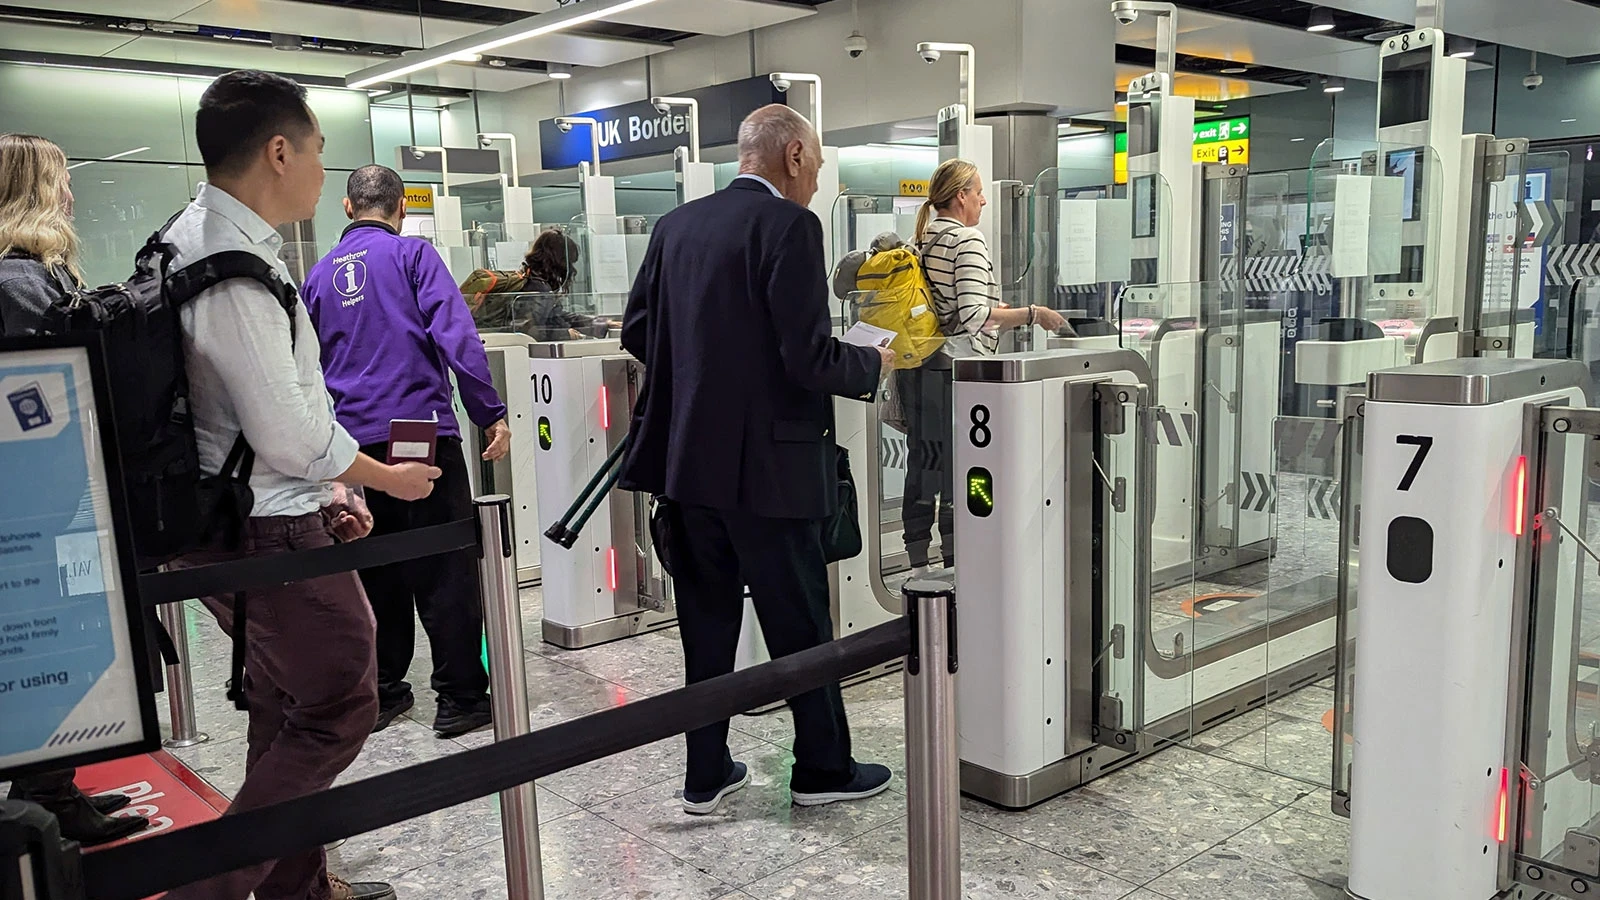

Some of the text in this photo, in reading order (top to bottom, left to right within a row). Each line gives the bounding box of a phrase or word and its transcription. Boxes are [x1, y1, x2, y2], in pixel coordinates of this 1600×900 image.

[1402, 34, 1409, 51] 8
[1141, 78, 1147, 91] 9
[597, 113, 690, 147] UK Border
[1199, 128, 1217, 138] exit
[1196, 148, 1215, 158] Exit
[333, 249, 368, 264] Heathrow
[342, 294, 365, 307] Helpers
[531, 373, 552, 404] 10
[969, 404, 992, 448] 8
[1396, 434, 1433, 491] 7
[11, 579, 21, 588] to
[24, 577, 40, 587] the
[3, 616, 57, 632] down front
[6, 632, 29, 643] hold
[32, 628, 59, 640] firmly
[20, 670, 69, 689] using
